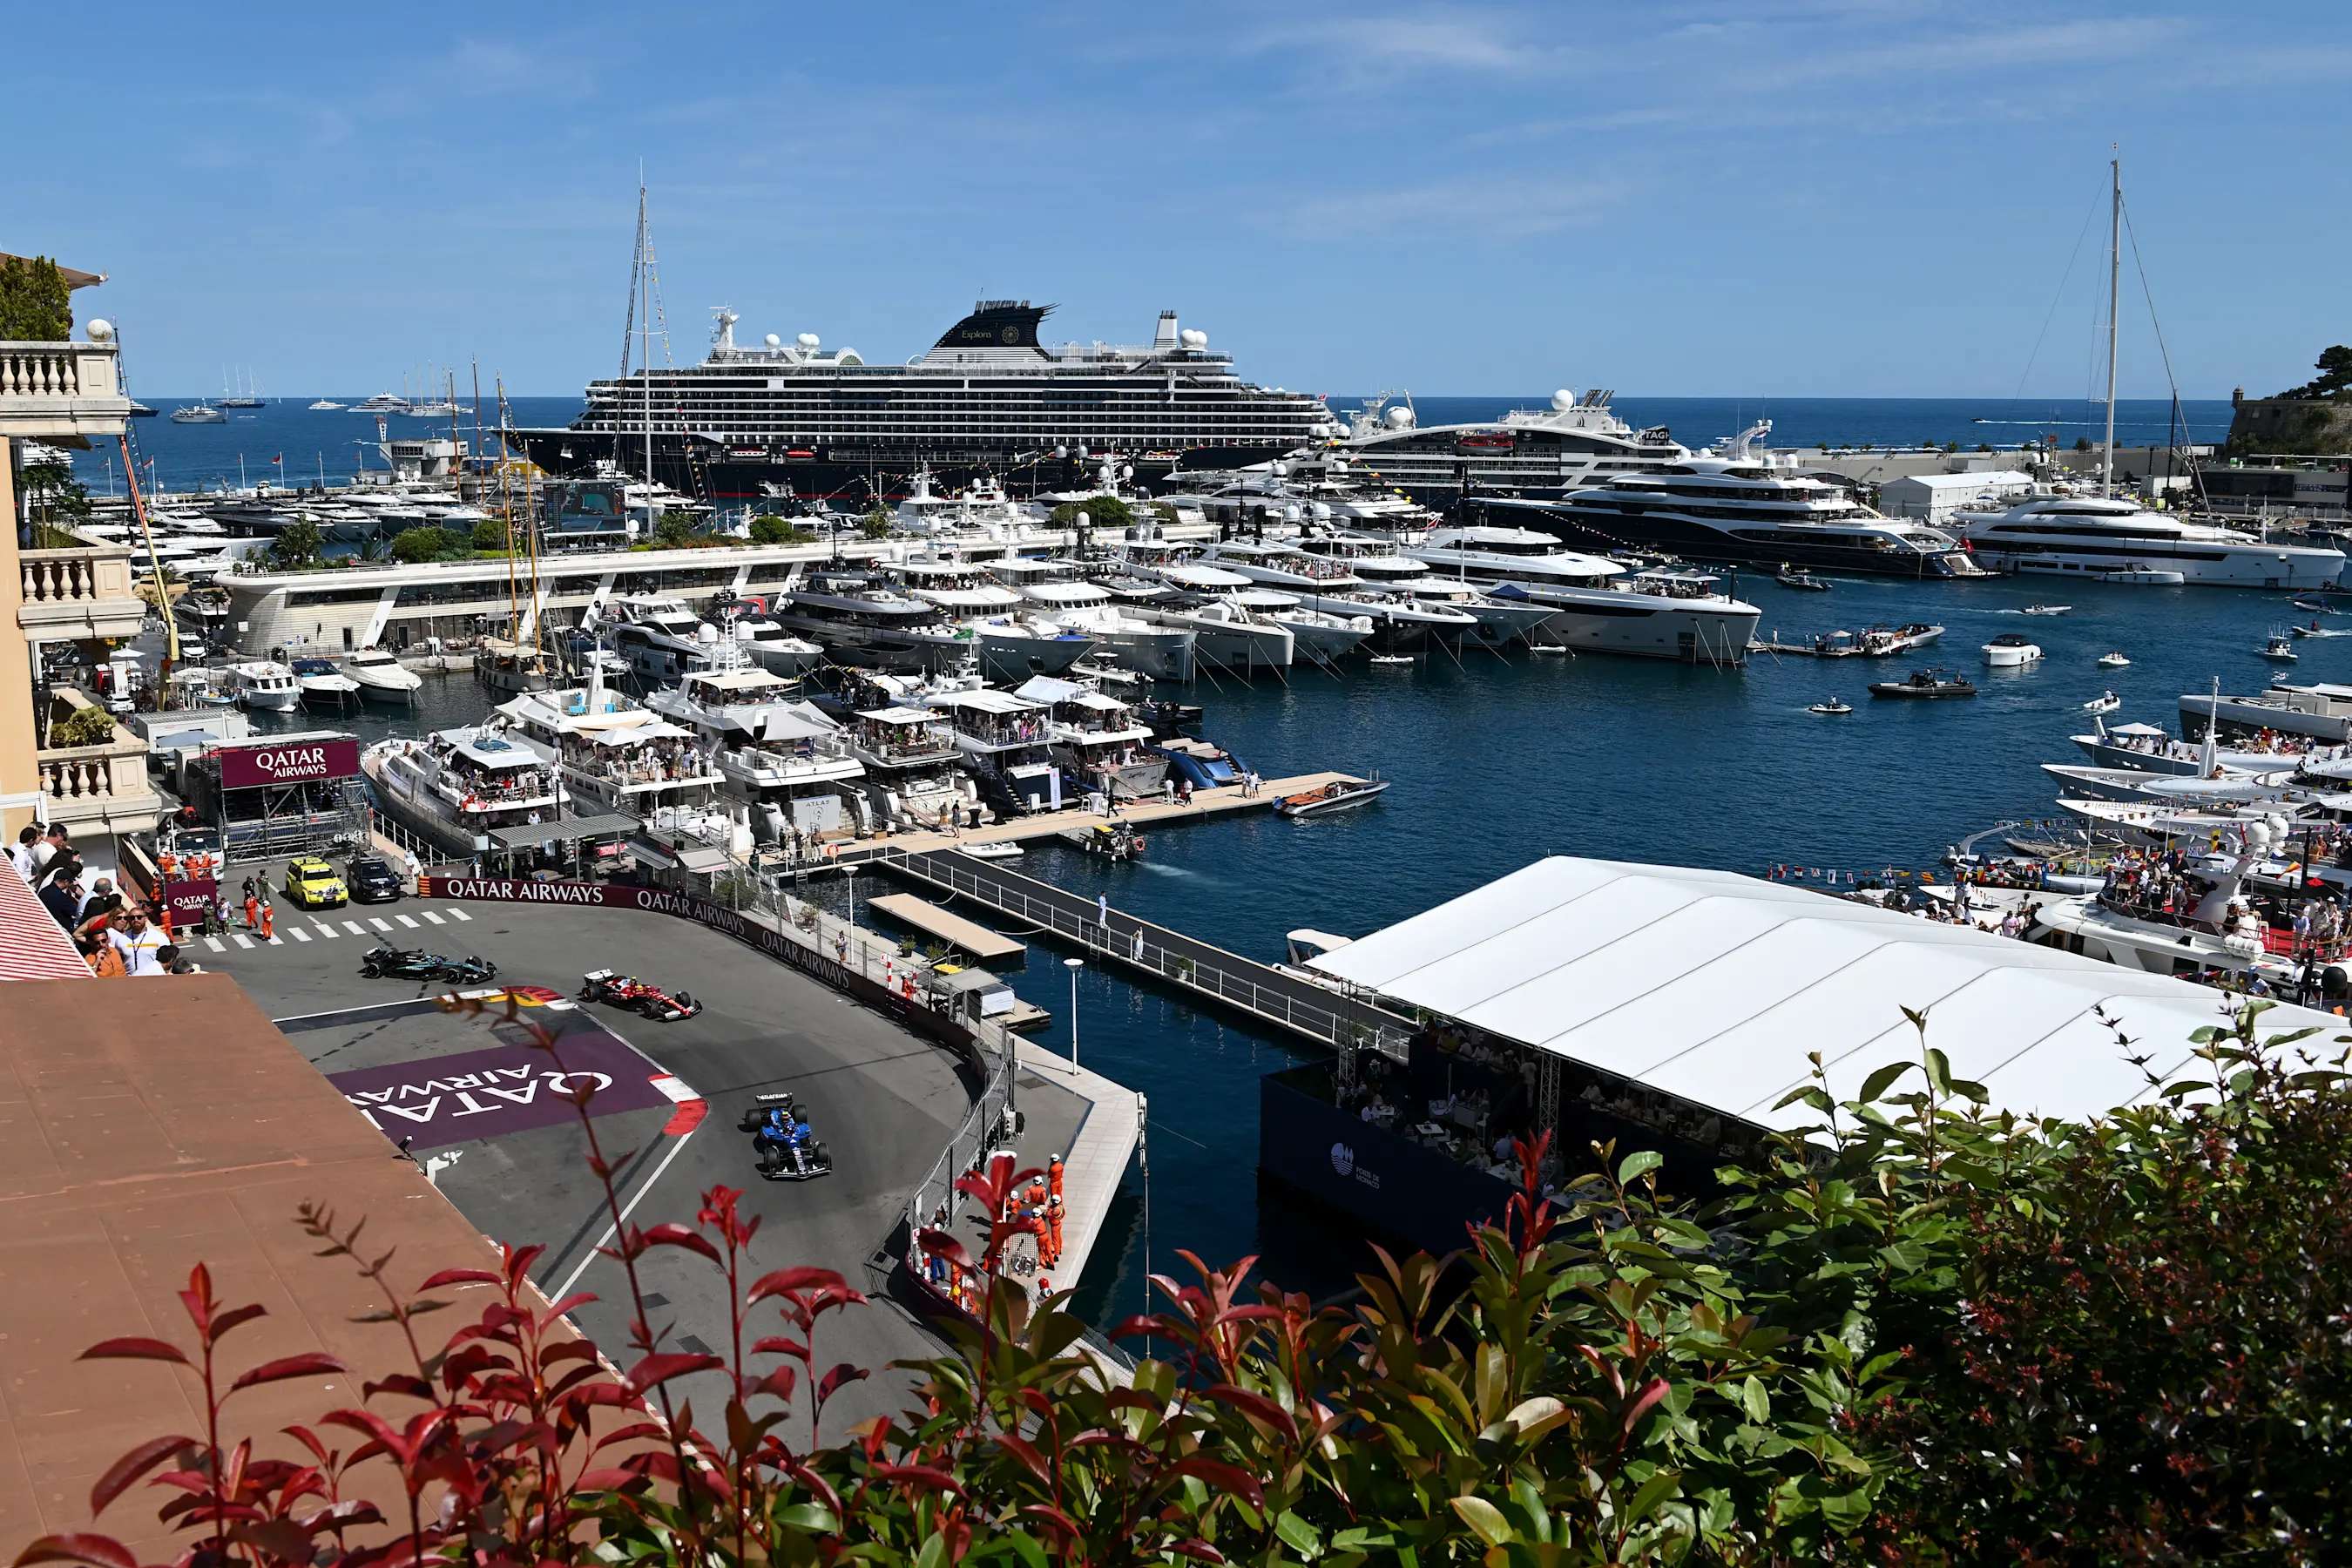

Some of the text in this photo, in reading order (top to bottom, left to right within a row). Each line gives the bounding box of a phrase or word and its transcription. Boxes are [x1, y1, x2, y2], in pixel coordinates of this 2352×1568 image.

[962, 330, 992, 341] Explora
[256, 747, 326, 772] QATAR
[274, 763, 328, 779] AIRWAYS
[806, 799, 830, 808] ATLAS
[447, 880, 604, 903] QATAR AIRWAYS
[637, 890, 746, 936] QATAR AIRWAYS
[762, 929, 849, 989] QATAR AIRWAYS
[359, 1071, 613, 1131] QATA
[1356, 1166, 1380, 1183] PORTS DE
[1356, 1173, 1380, 1189] MONACO
